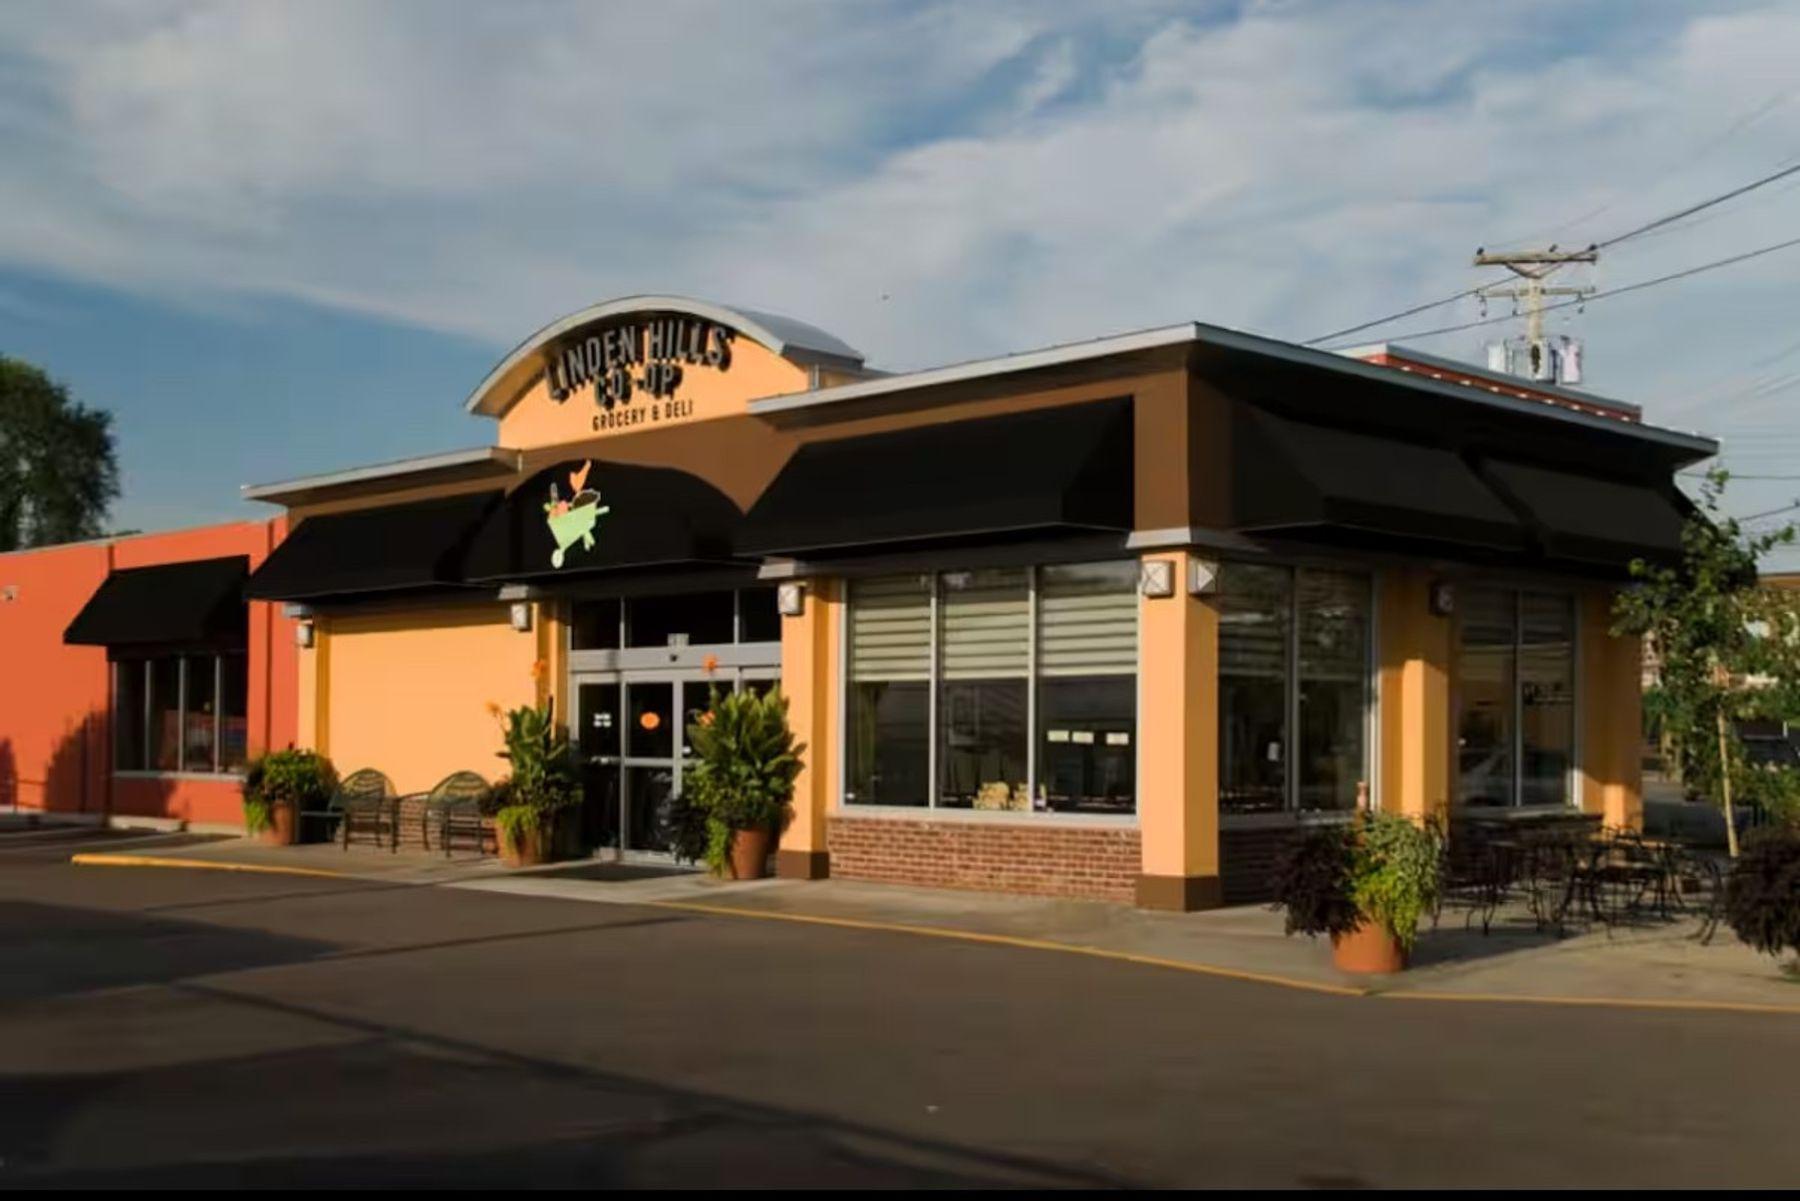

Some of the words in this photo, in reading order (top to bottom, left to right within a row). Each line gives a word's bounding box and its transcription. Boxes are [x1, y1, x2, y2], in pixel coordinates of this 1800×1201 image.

[545, 325, 637, 400] LINDEN
[647, 319, 727, 369] HILLS
[592, 409, 646, 431] GROCERY
[652, 406, 660, 421] &
[665, 400, 693, 419] DELI
